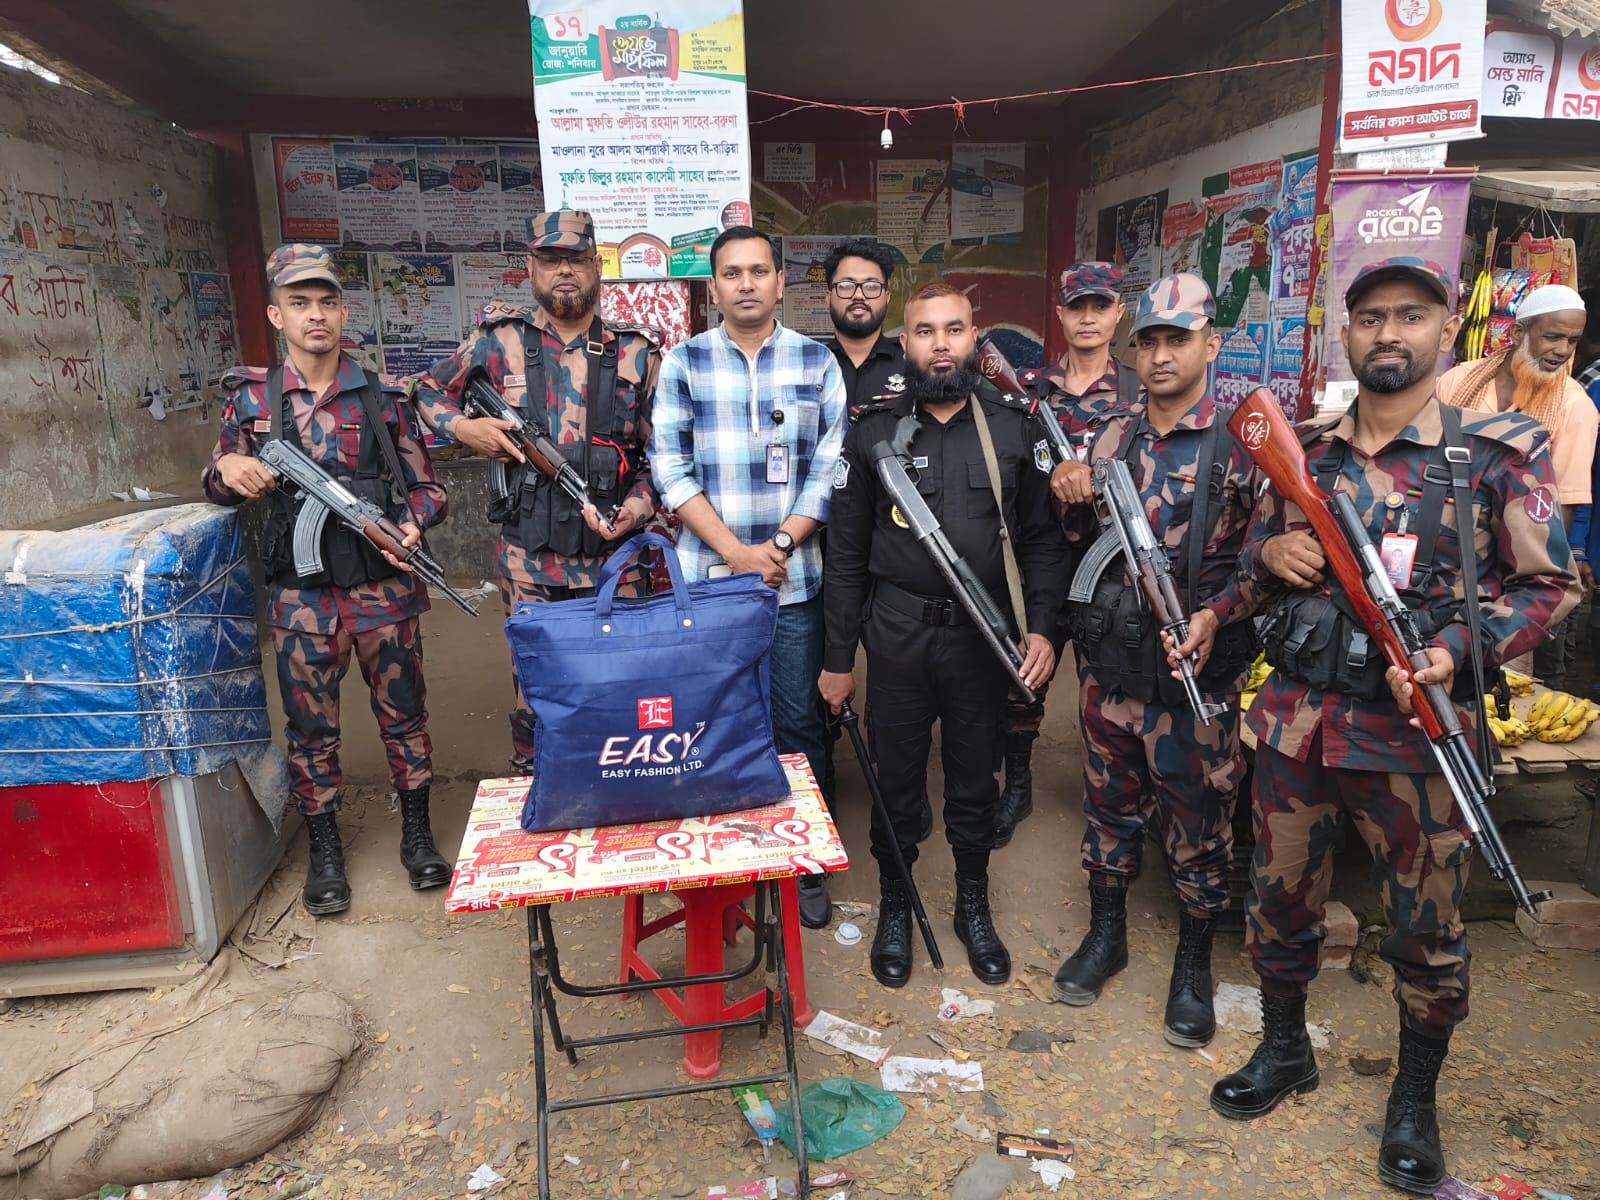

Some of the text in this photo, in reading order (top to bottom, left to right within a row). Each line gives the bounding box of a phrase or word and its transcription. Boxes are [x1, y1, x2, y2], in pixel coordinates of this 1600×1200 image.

[554, 15, 582, 38] ১৭
[547, 42, 588, 60] জানুয়ারি
[1502, 50, 1536, 65] অ্যাপে
[566, 57, 596, 69] শনিবার
[1368, 43, 1462, 87] নগদ
[1487, 65, 1545, 83] সেন্ড মানি
[1405, 82, 1434, 96] ডিজিটাল
[1502, 84, 1526, 107] ফ্রি
[551, 116, 583, 133] আল্লামা
[586, 113, 614, 134] মুফতি
[651, 115, 680, 131] রহমান
[1387, 115, 1415, 128] ক্যাশ
[1416, 108, 1447, 125] আউট
[1449, 104, 1472, 121] চার্জ
[551, 146, 586, 157] মাওলানা
[607, 145, 632, 156] আলম
[633, 141, 670, 156] আশরাফী
[672, 144, 698, 156] সাহেব
[559, 168, 586, 189] মুফতি
[615, 172, 643, 185] রহমান
[645, 166, 676, 185] কাসেমী
[678, 170, 705, 183] সাহেব
[1366, 208, 1403, 218] ROCKET
[1358, 206, 1444, 244] রকেট
[598, 727, 705, 766] EASY
[601, 760, 705, 779] EASY FASHION LTD.
[629, 865, 658, 873] airtel
[490, 880, 521, 889] airtel
